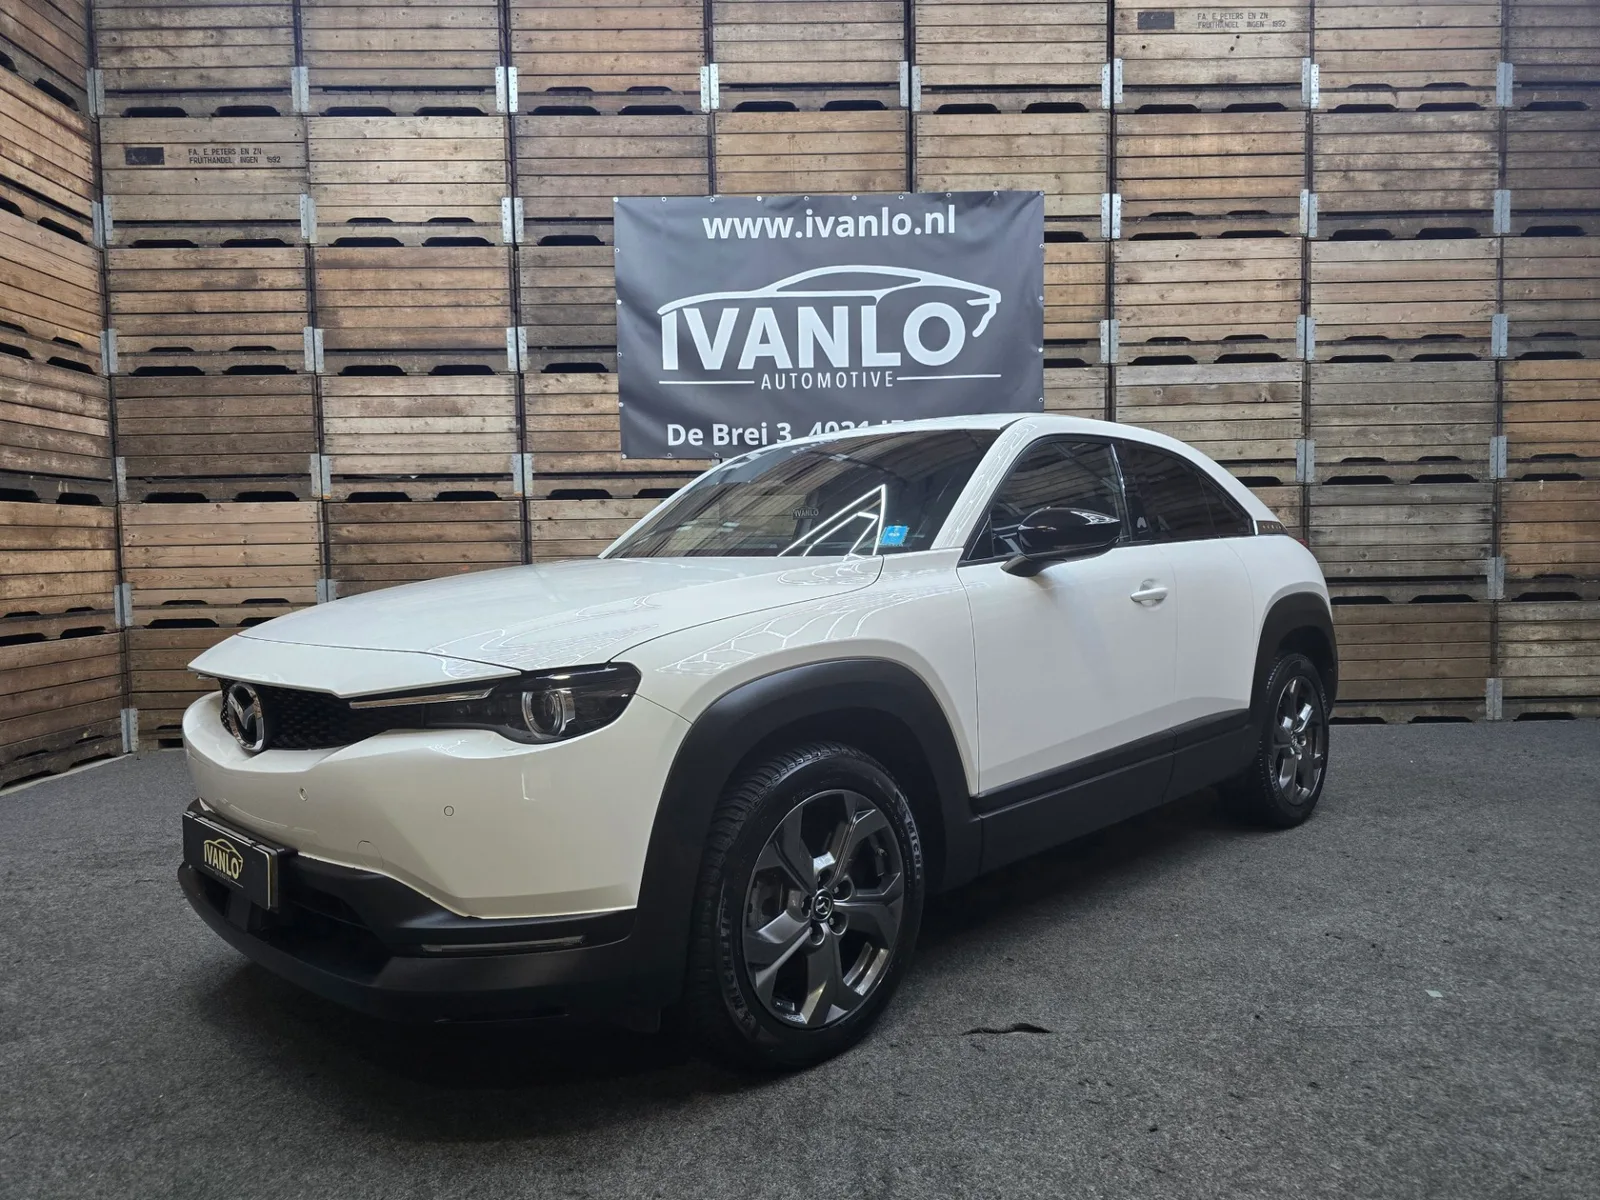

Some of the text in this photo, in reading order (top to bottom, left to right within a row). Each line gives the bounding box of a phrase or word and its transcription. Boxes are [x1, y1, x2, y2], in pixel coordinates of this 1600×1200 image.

[1247, 12, 1257, 20] EN
[240, 147, 250, 155] EN
[252, 147, 262, 155] ZN
[703, 204, 956, 239] www.ivanlo.nl
[661, 302, 966, 371] IVANLO
[760, 371, 894, 390] AUTOMOTIVE
[667, 423, 704, 446] De
[713, 421, 767, 446] Brei
[204, 843, 239, 879] IVANLO
